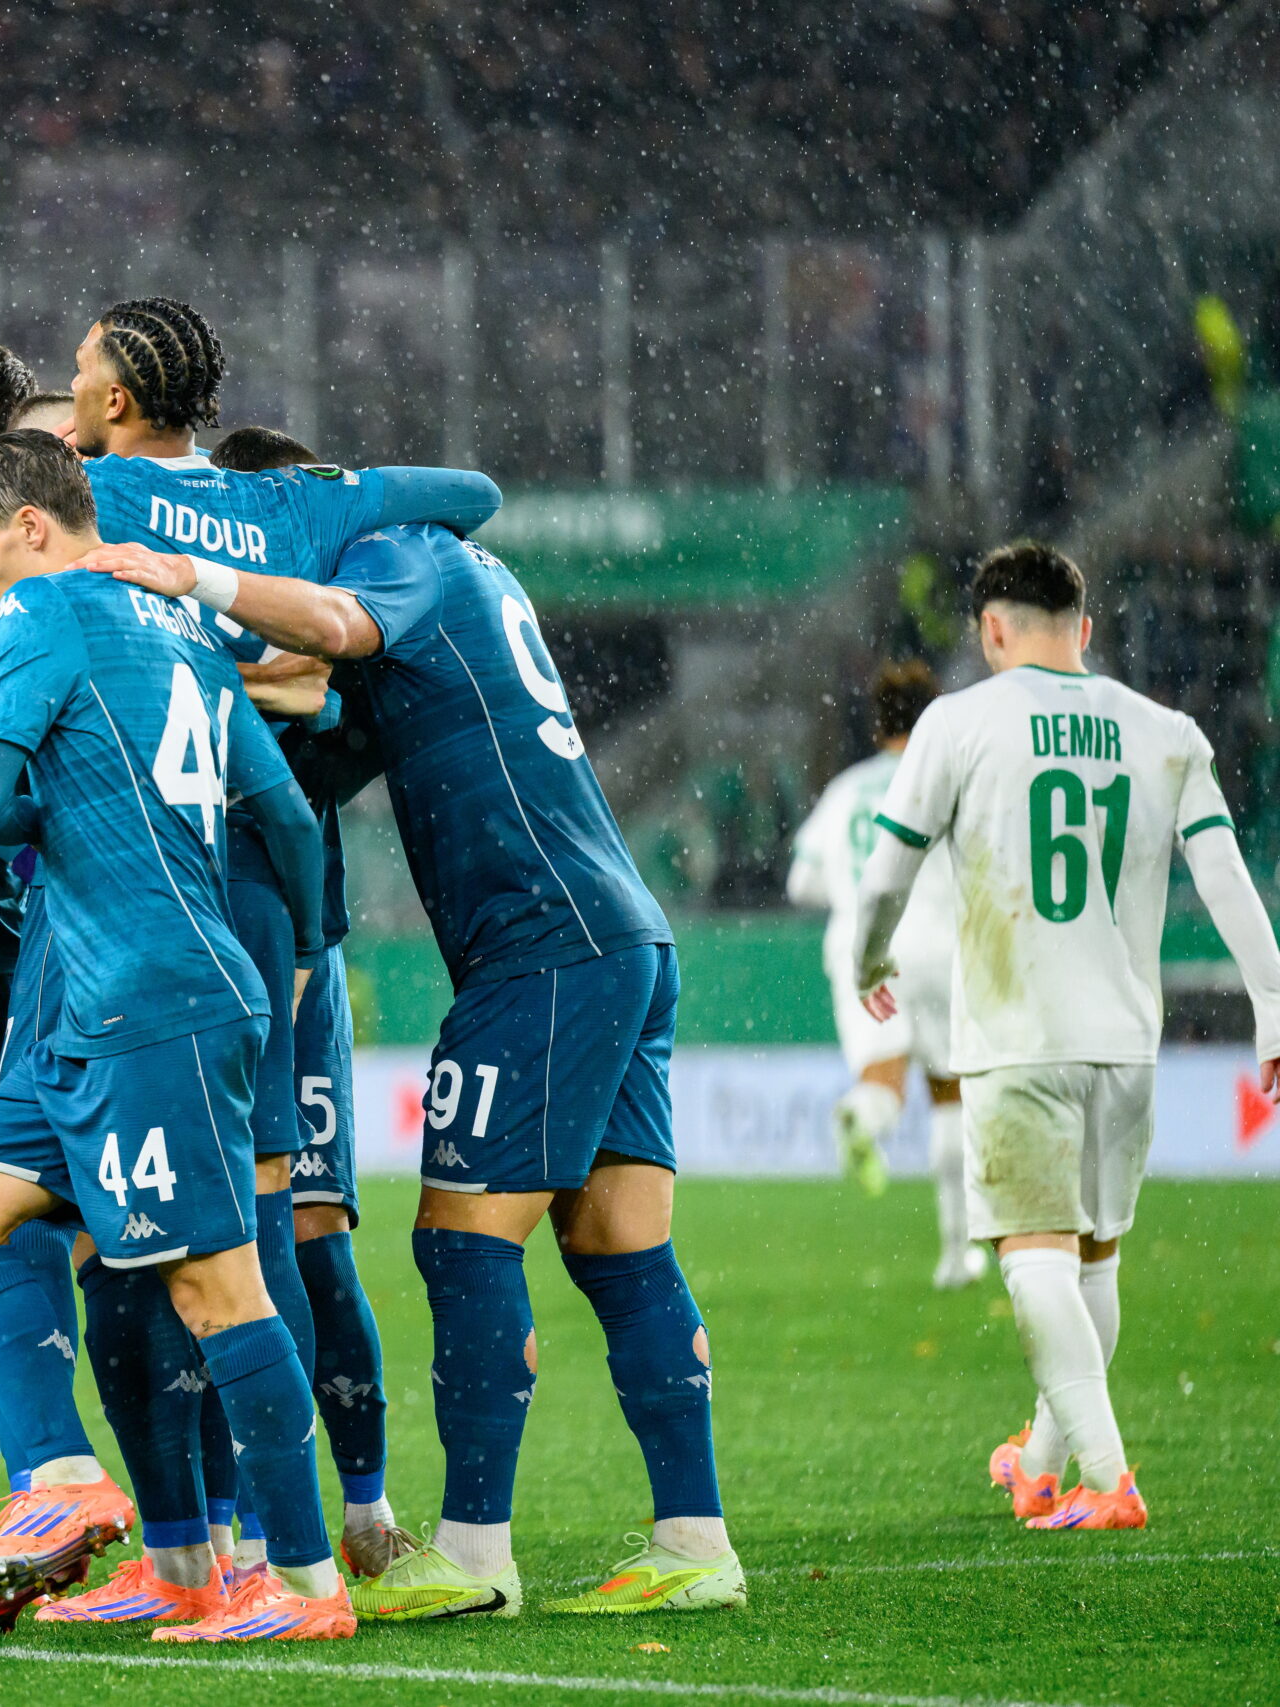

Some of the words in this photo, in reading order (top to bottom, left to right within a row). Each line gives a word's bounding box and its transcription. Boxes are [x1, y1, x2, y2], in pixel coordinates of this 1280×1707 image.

[149, 494, 267, 564] NDOUR
[1030, 713, 1122, 762] DEMIR
[1029, 768, 1131, 925] 61
[427, 1059, 499, 1138] 91
[98, 1126, 177, 1207] 44
